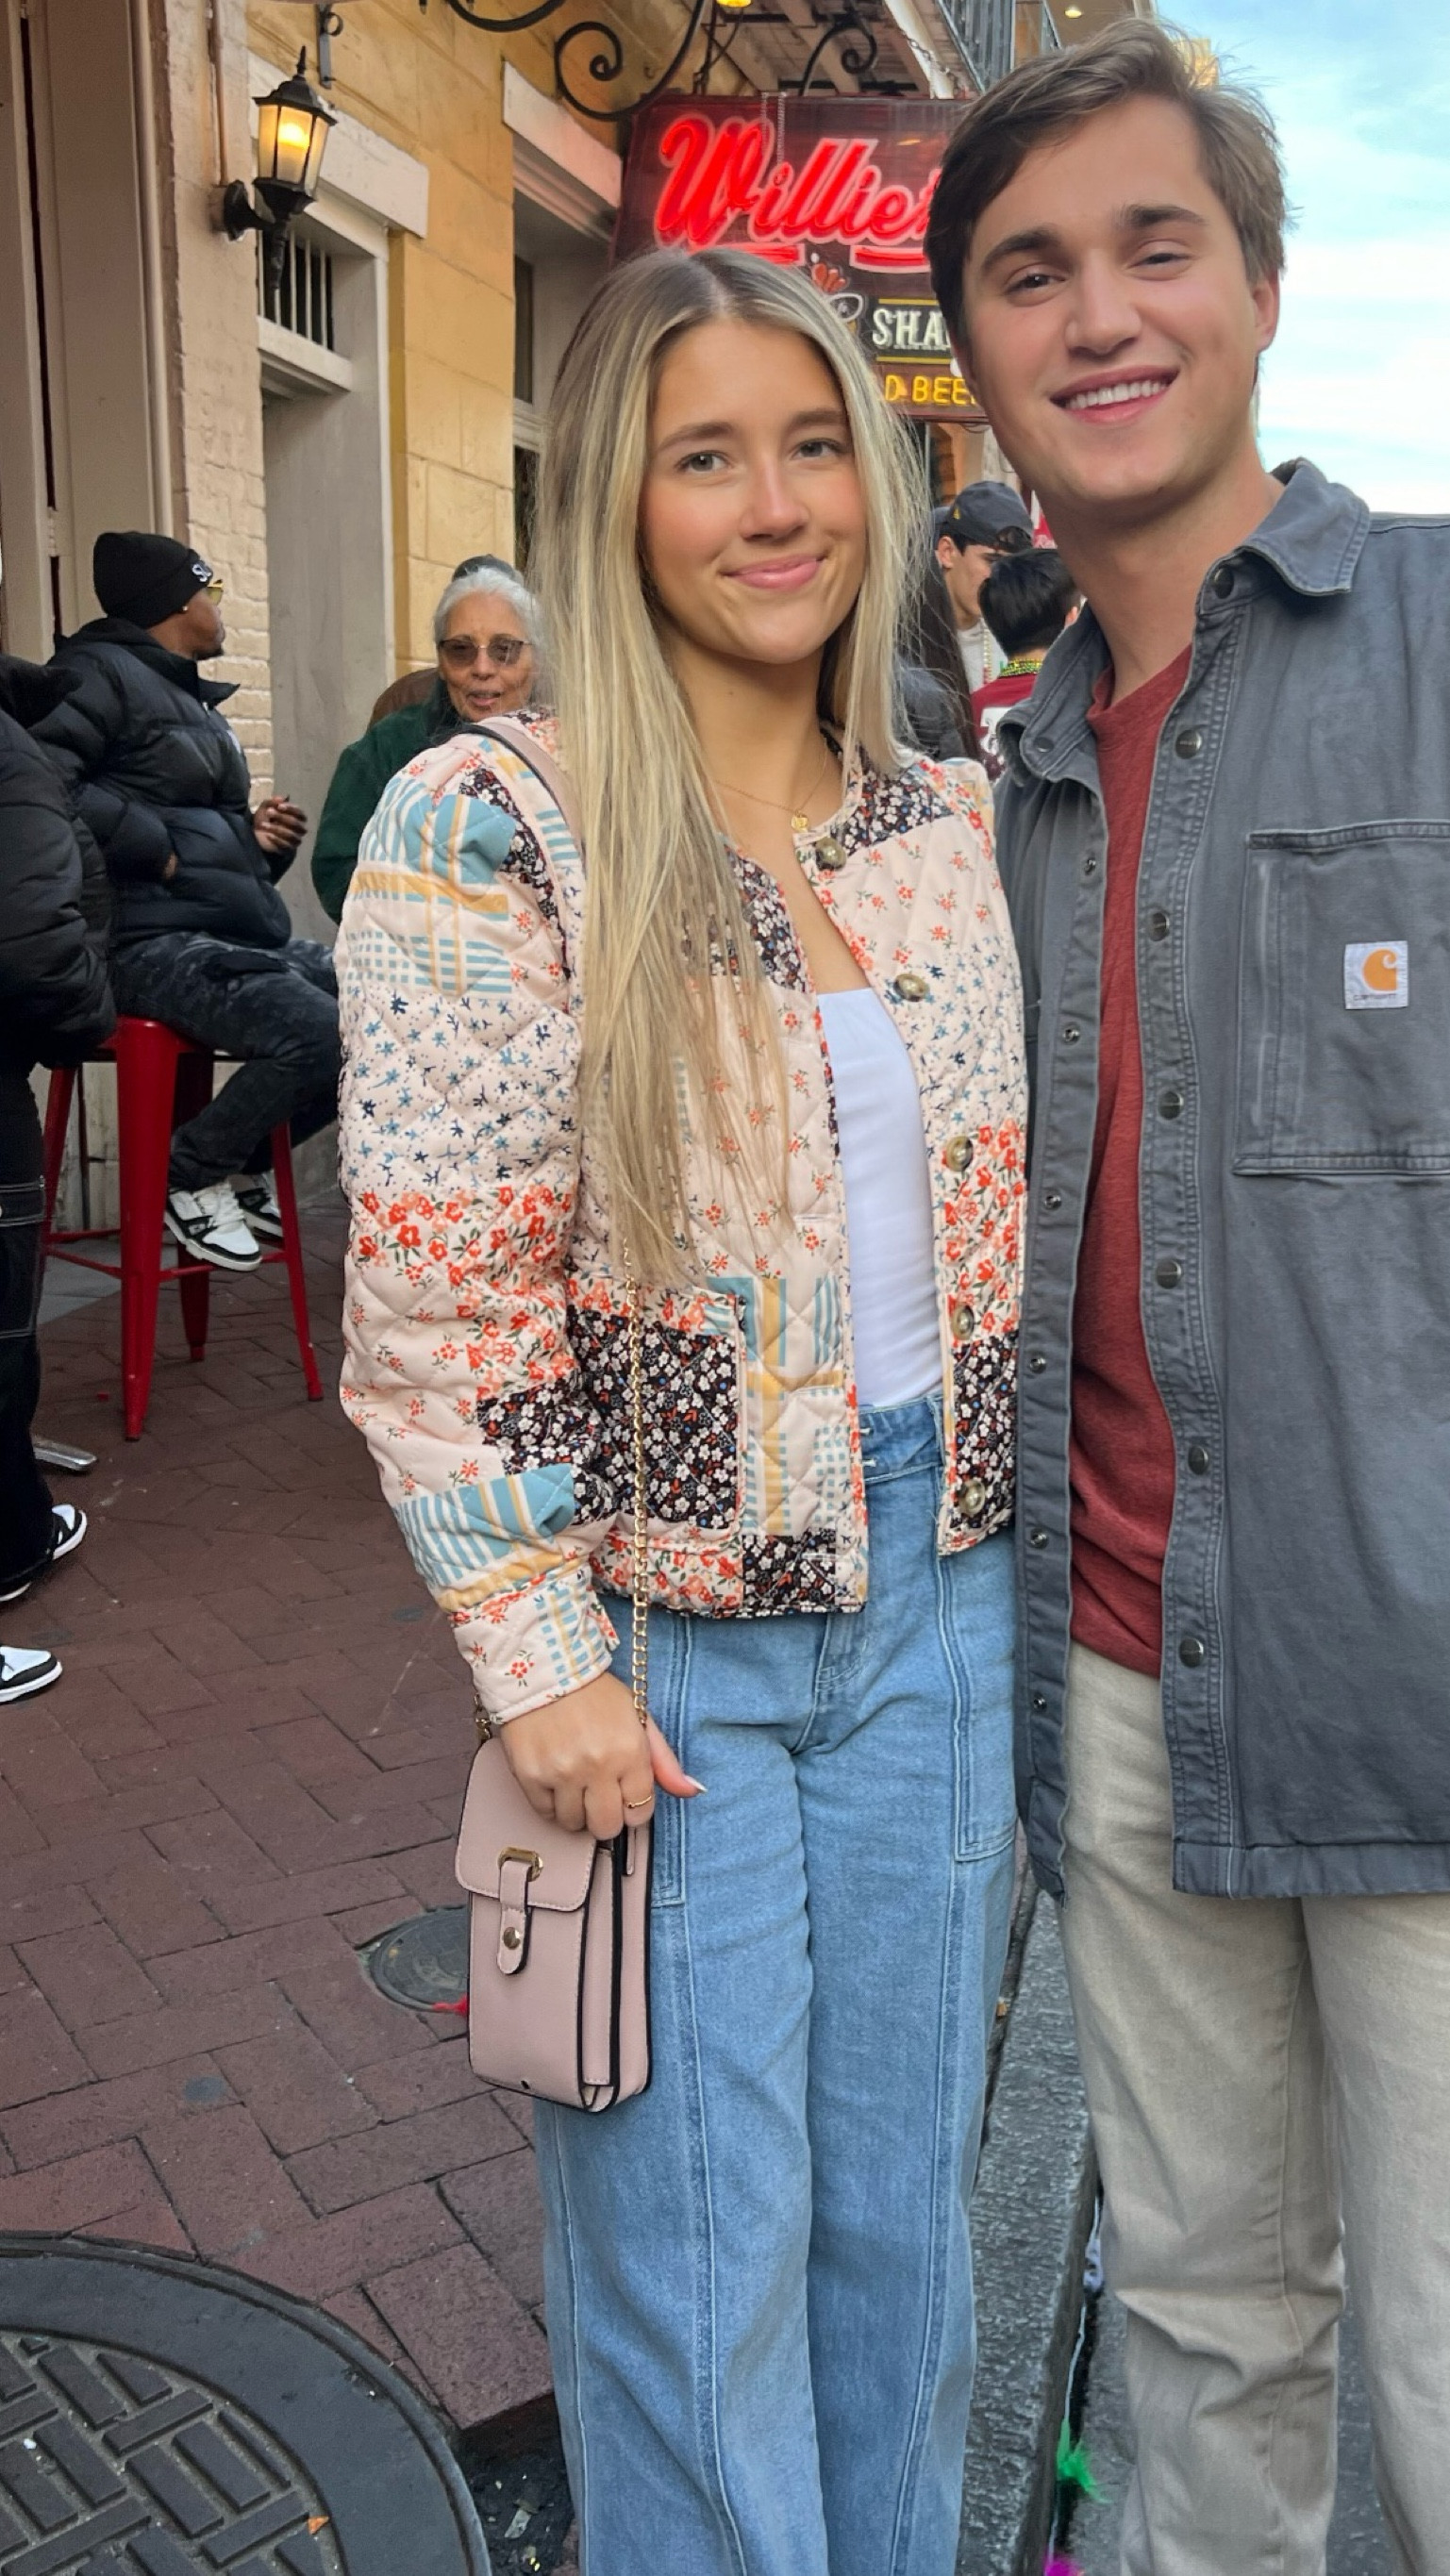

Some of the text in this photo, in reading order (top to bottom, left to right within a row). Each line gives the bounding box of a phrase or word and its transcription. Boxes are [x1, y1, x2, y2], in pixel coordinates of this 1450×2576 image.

[655, 113, 942, 246] Willie
[873, 307, 951, 350] SHA
[911, 375, 976, 405] BEE
